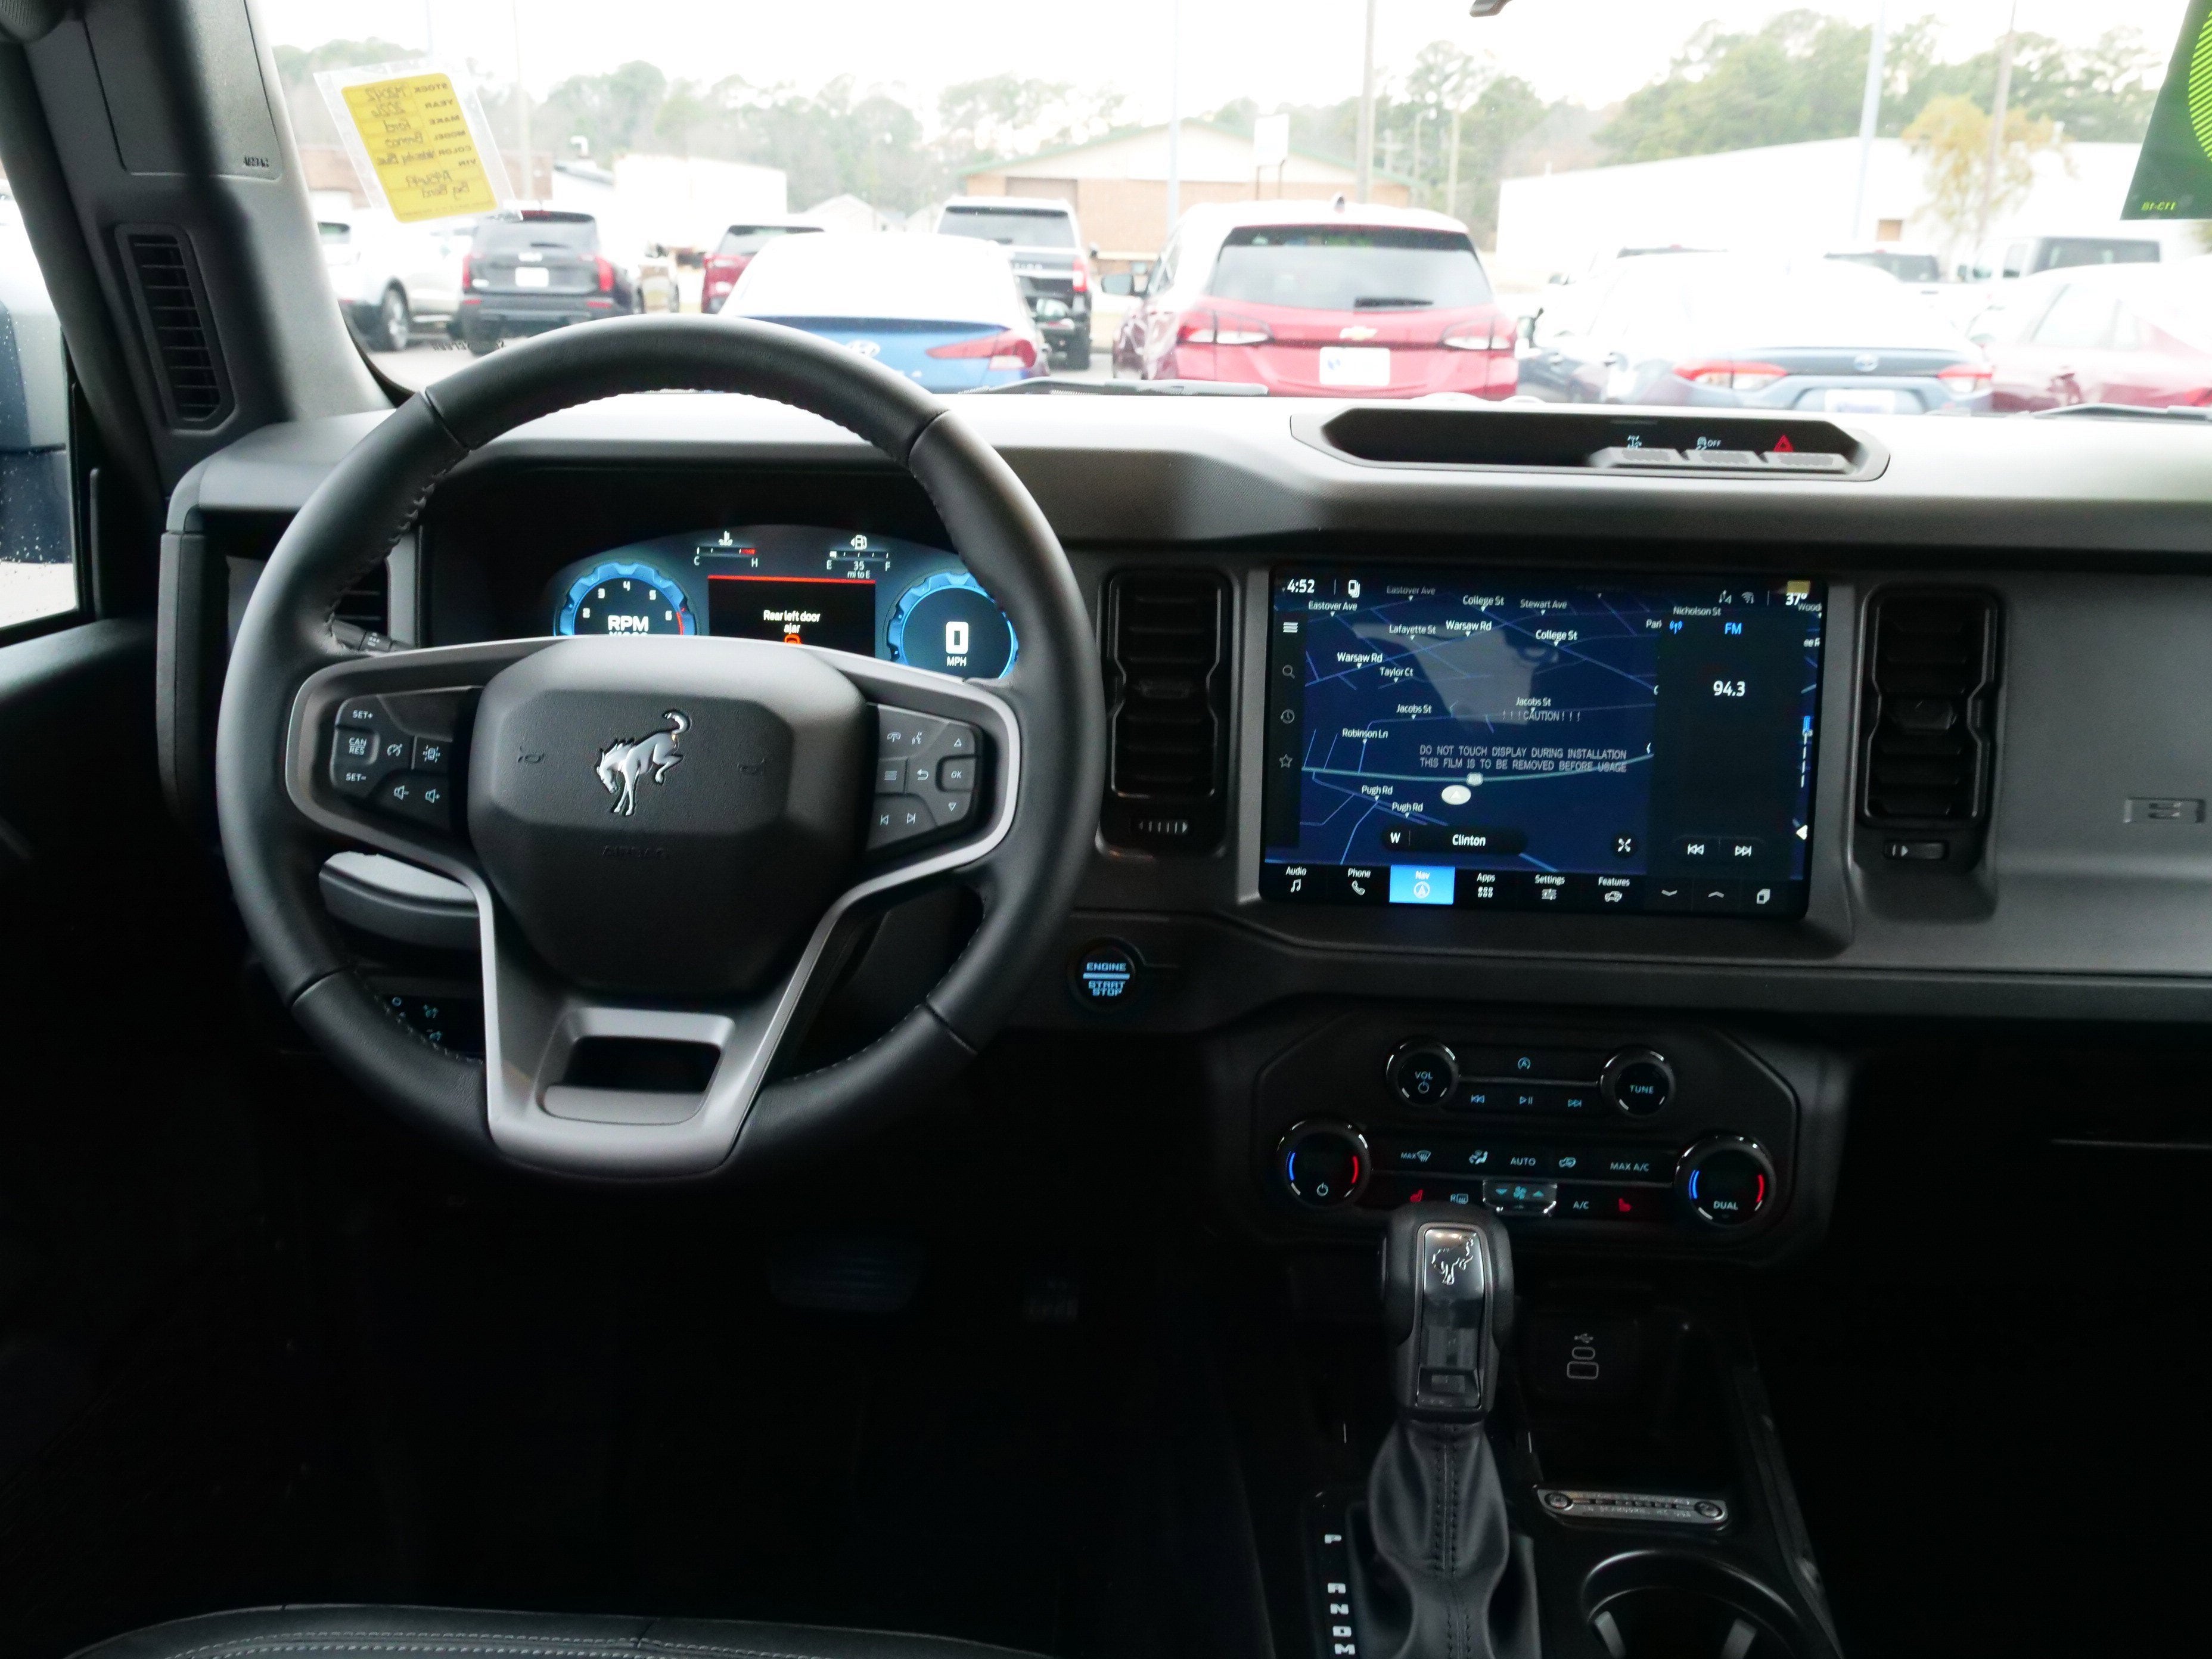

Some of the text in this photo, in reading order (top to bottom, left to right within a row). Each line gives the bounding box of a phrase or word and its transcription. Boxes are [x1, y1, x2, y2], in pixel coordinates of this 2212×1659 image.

[694, 555, 700, 566] C
[751, 557, 758, 567] H
[827, 560, 832, 570] E
[853, 560, 865, 570] 35
[885, 561, 891, 571] F
[623, 580, 630, 591] 4
[1287, 579, 1315, 593] 4:52
[1386, 585, 1436, 595] Eastover Ave
[1308, 601, 1358, 611] Eastover Ave
[1462, 595, 1505, 607] College St
[1520, 598, 1567, 610] Stewart Ave
[763, 610, 821, 622] Rear left door
[1673, 606, 1722, 617] Nicholson St
[607, 615, 649, 632] RPM
[784, 622, 800, 635] ajar
[1445, 620, 1492, 631] Warsaw Rd
[1724, 622, 1743, 635] FM
[1388, 624, 1437, 636] Lafayette St
[1536, 629, 1578, 641] College St
[946, 621, 969, 654] 0
[946, 656, 967, 667] MPH
[1337, 652, 1383, 663] Warsaw Rd
[1380, 667, 1414, 678] Taylor Ct
[1713, 680, 1746, 697] 94.3
[1516, 697, 1552, 707] Jacobs St
[1396, 704, 1433, 714] Jacobs St
[1342, 728, 1388, 739] Robinson Ln
[1419, 745, 1627, 760] DO NOT TOUCH DISPLAY DURING INSTALLATION
[1419, 757, 1627, 773] THIS FILM IS TO BE REMOVED BEFORE USAGE
[950, 770, 962, 779] OK
[1362, 784, 1393, 796] Pugh Rd
[1392, 801, 1424, 813] Pugh Rd
[1390, 832, 1400, 844] W
[1452, 834, 1486, 847] Clinton
[1286, 866, 1307, 876] Audio
[1347, 868, 1371, 878] Phone
[1415, 870, 1431, 880] Nav
[1477, 872, 1496, 884] Apps
[1534, 874, 1565, 886] Settings
[1598, 876, 1630, 887] Features
[1086, 962, 1127, 972] ENGINE
[1088, 980, 1126, 989] START
[1092, 988, 1123, 996] STOP
[1415, 1071, 1433, 1080] VOL
[1630, 1084, 1654, 1095] TUNE
[1510, 1157, 1536, 1167] AUTO
[1610, 1161, 1650, 1173] MAX A/C
[1573, 1200, 1589, 1210] A/C
[1713, 1200, 1739, 1211] DUAL
[1324, 1534, 1342, 1544] P
[1330, 1603, 1349, 1615] N
[1332, 1626, 1352, 1637] D
[1334, 1643, 1356, 1655] M
